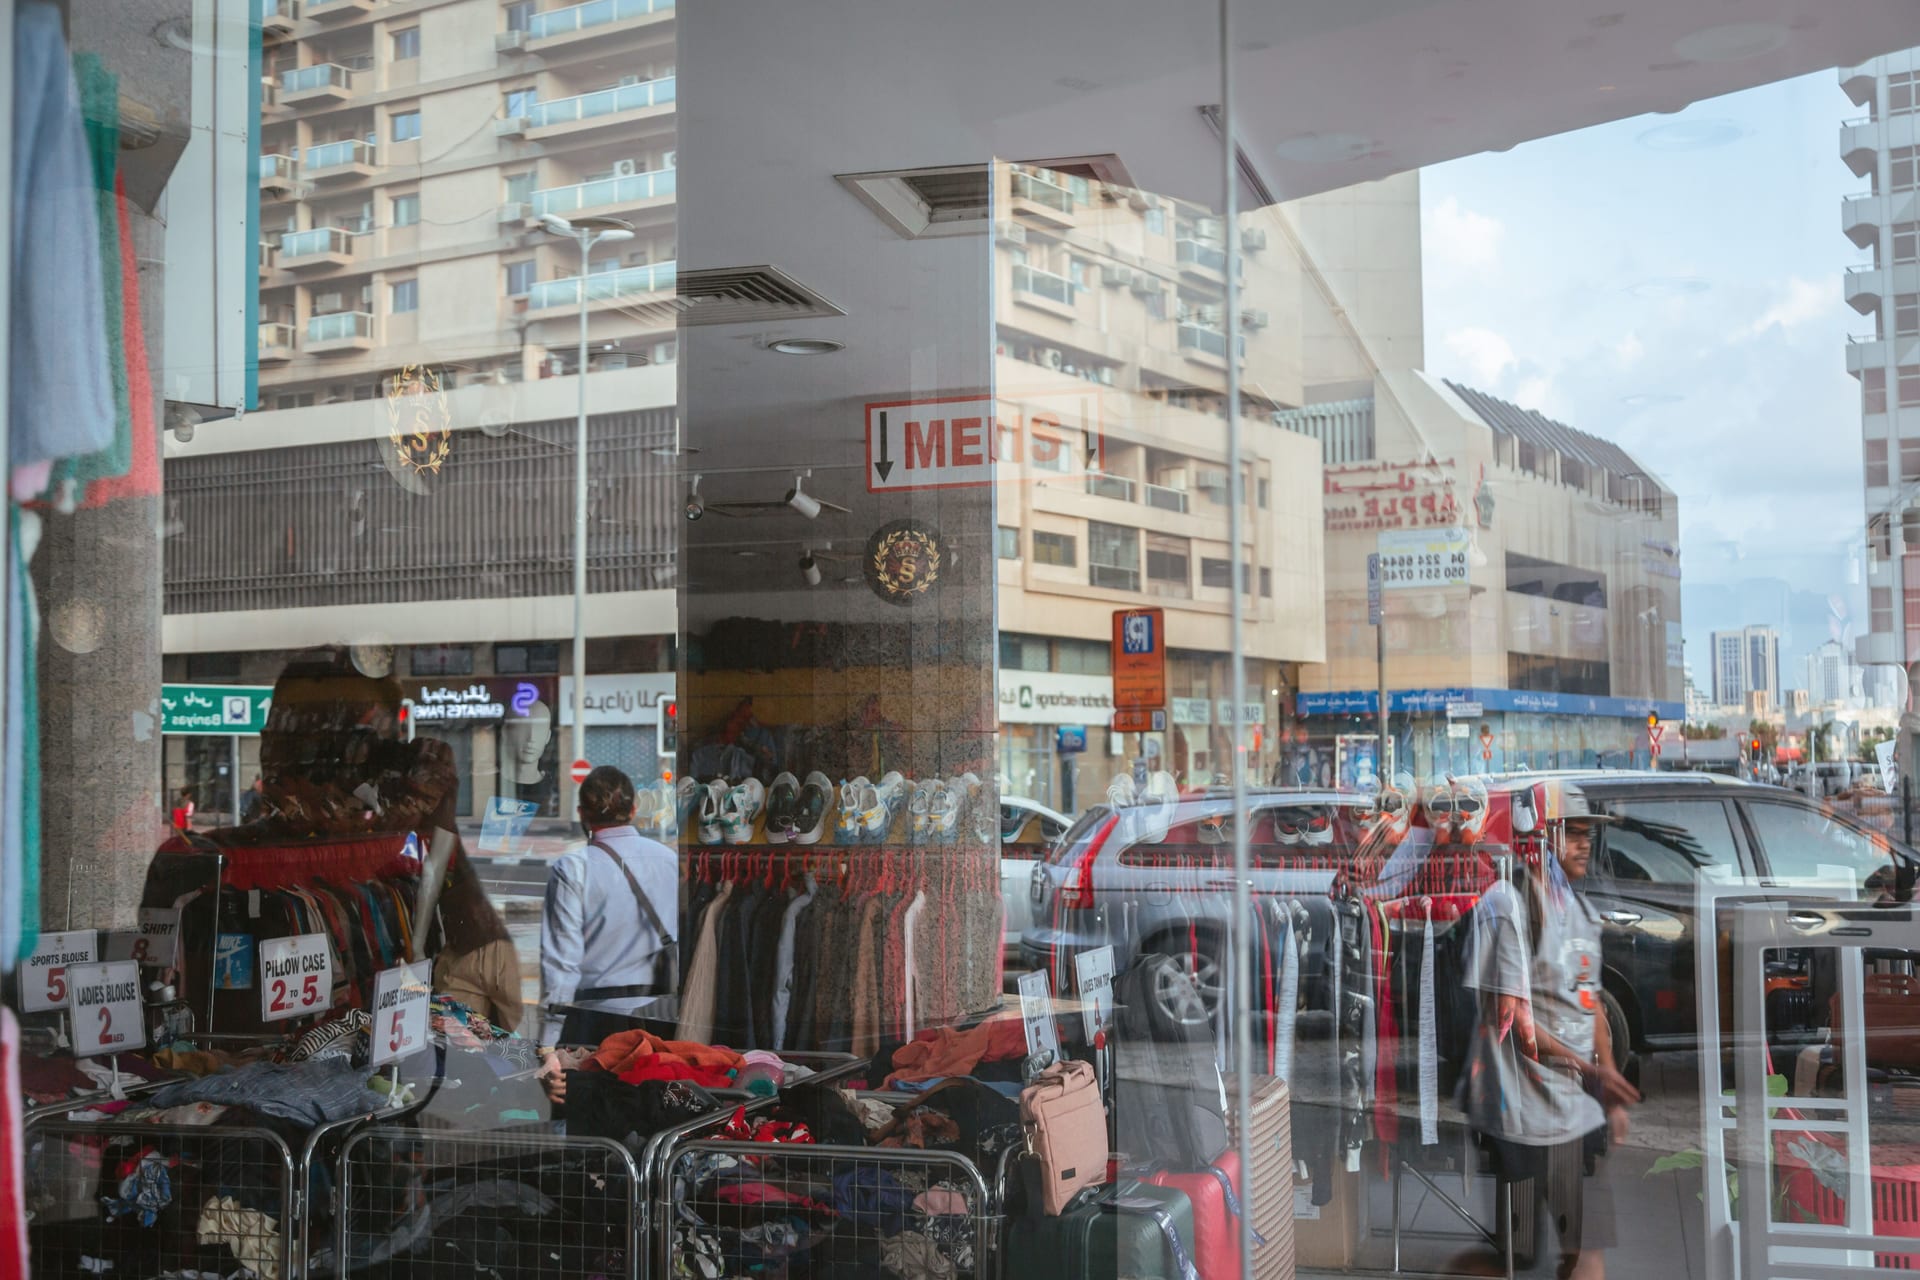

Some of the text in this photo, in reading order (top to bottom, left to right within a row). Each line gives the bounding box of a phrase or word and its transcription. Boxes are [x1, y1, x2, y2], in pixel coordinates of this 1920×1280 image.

[142, 922, 175, 936] SHIRT
[131, 938, 150, 961] 8
[218, 935, 243, 949] NIKE
[31, 951, 89, 967] SPORTS BLOUSE
[265, 953, 325, 979] PILLOW CASE
[47, 967, 66, 1003] 5
[1102, 972, 1110, 988] TOP
[77, 982, 136, 1006] LADIES BLOUSE
[270, 979, 287, 1012] 2
[290, 989, 299, 998] TO
[302, 975, 318, 1006] 5
[378, 988, 399, 1010] LADIES
[98, 1006, 125, 1045] 2 AED
[389, 1009, 406, 1052] 5
